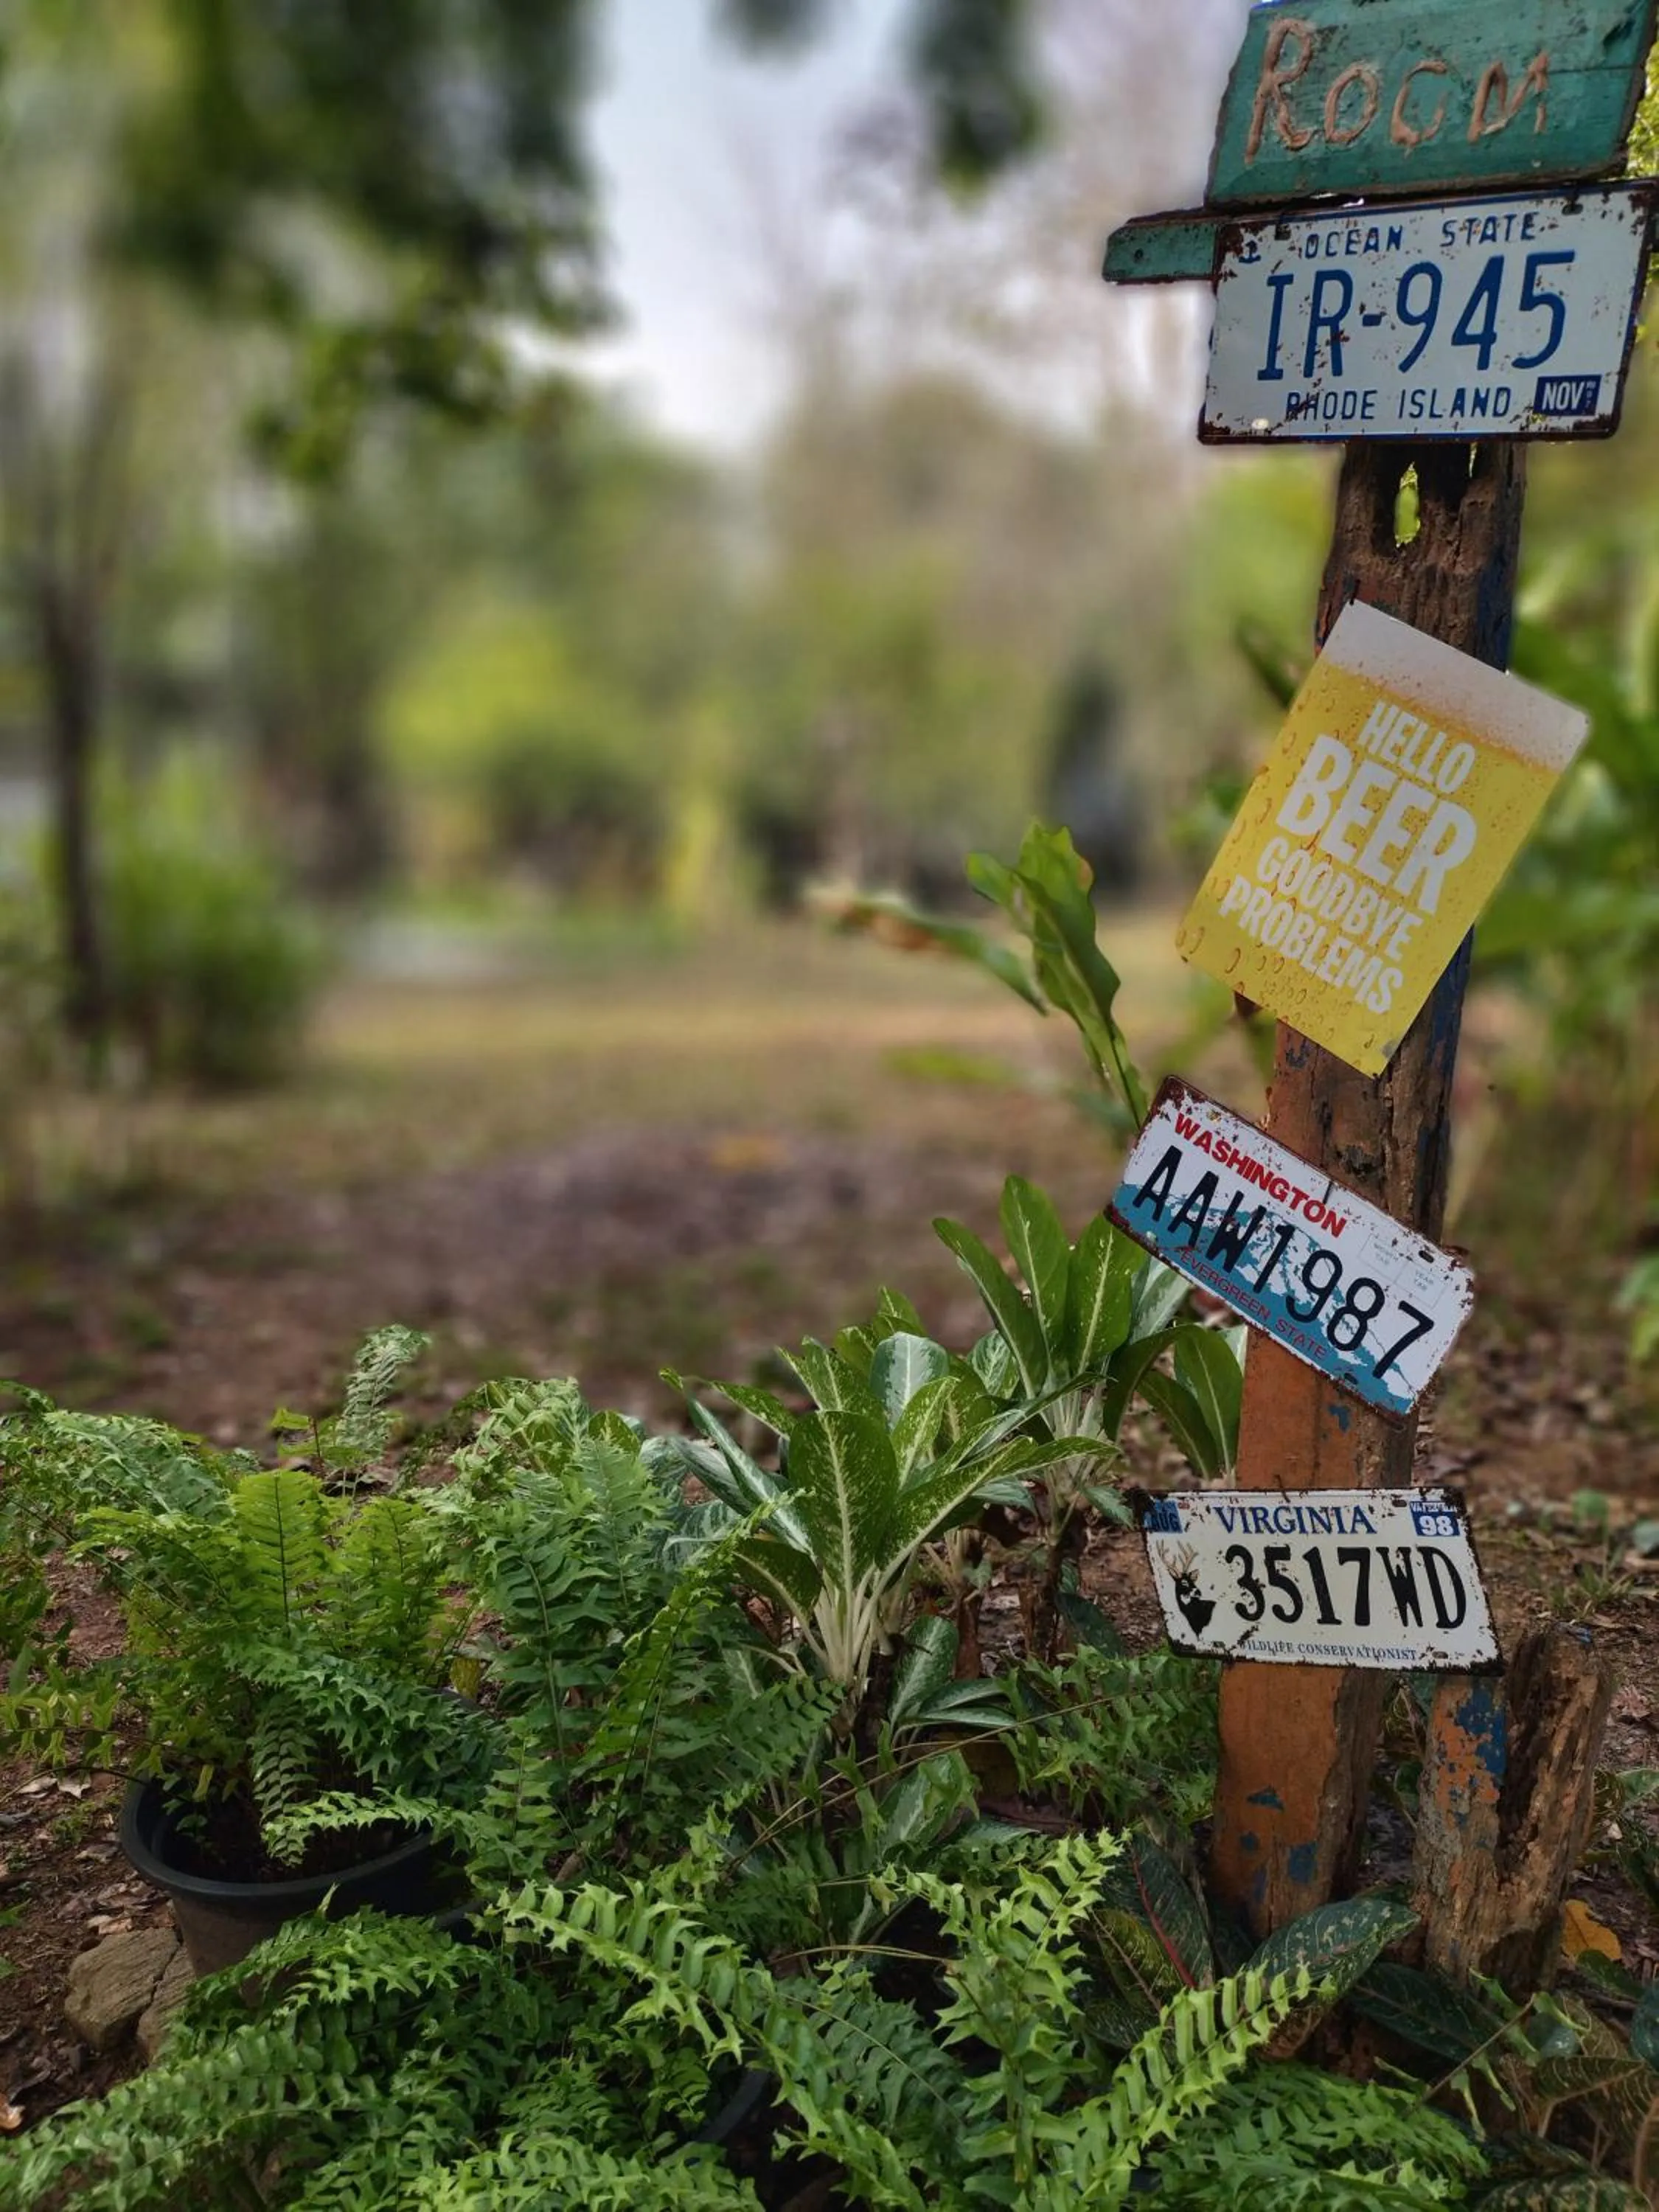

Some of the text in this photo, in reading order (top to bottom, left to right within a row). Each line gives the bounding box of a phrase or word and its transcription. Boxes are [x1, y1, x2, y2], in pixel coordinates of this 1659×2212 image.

[1304, 212, 1540, 260] OCEAN STATE
[1256, 249, 1576, 381] IR-945
[1285, 386, 1512, 420] RHODE ISLAND
[1542, 380, 1585, 411] NOV
[1359, 702, 1476, 795] HELLO
[1276, 734, 1477, 917] BEER
[1219, 874, 1404, 1015] PROBLEMS
[1256, 836, 1424, 961] GOODBYE
[1174, 1114, 1346, 1238] WASHINGTON
[1133, 1145, 1435, 1380] AAW1987
[1179, 1250, 1328, 1361] EVERGREEN STATE
[1214, 1505, 1378, 1534] VIRGINIA
[1419, 1514, 1455, 1536] 98
[1225, 1545, 1467, 1629] 3517WD
[1296, 1641, 1417, 1660] CONSERVATIONIST
